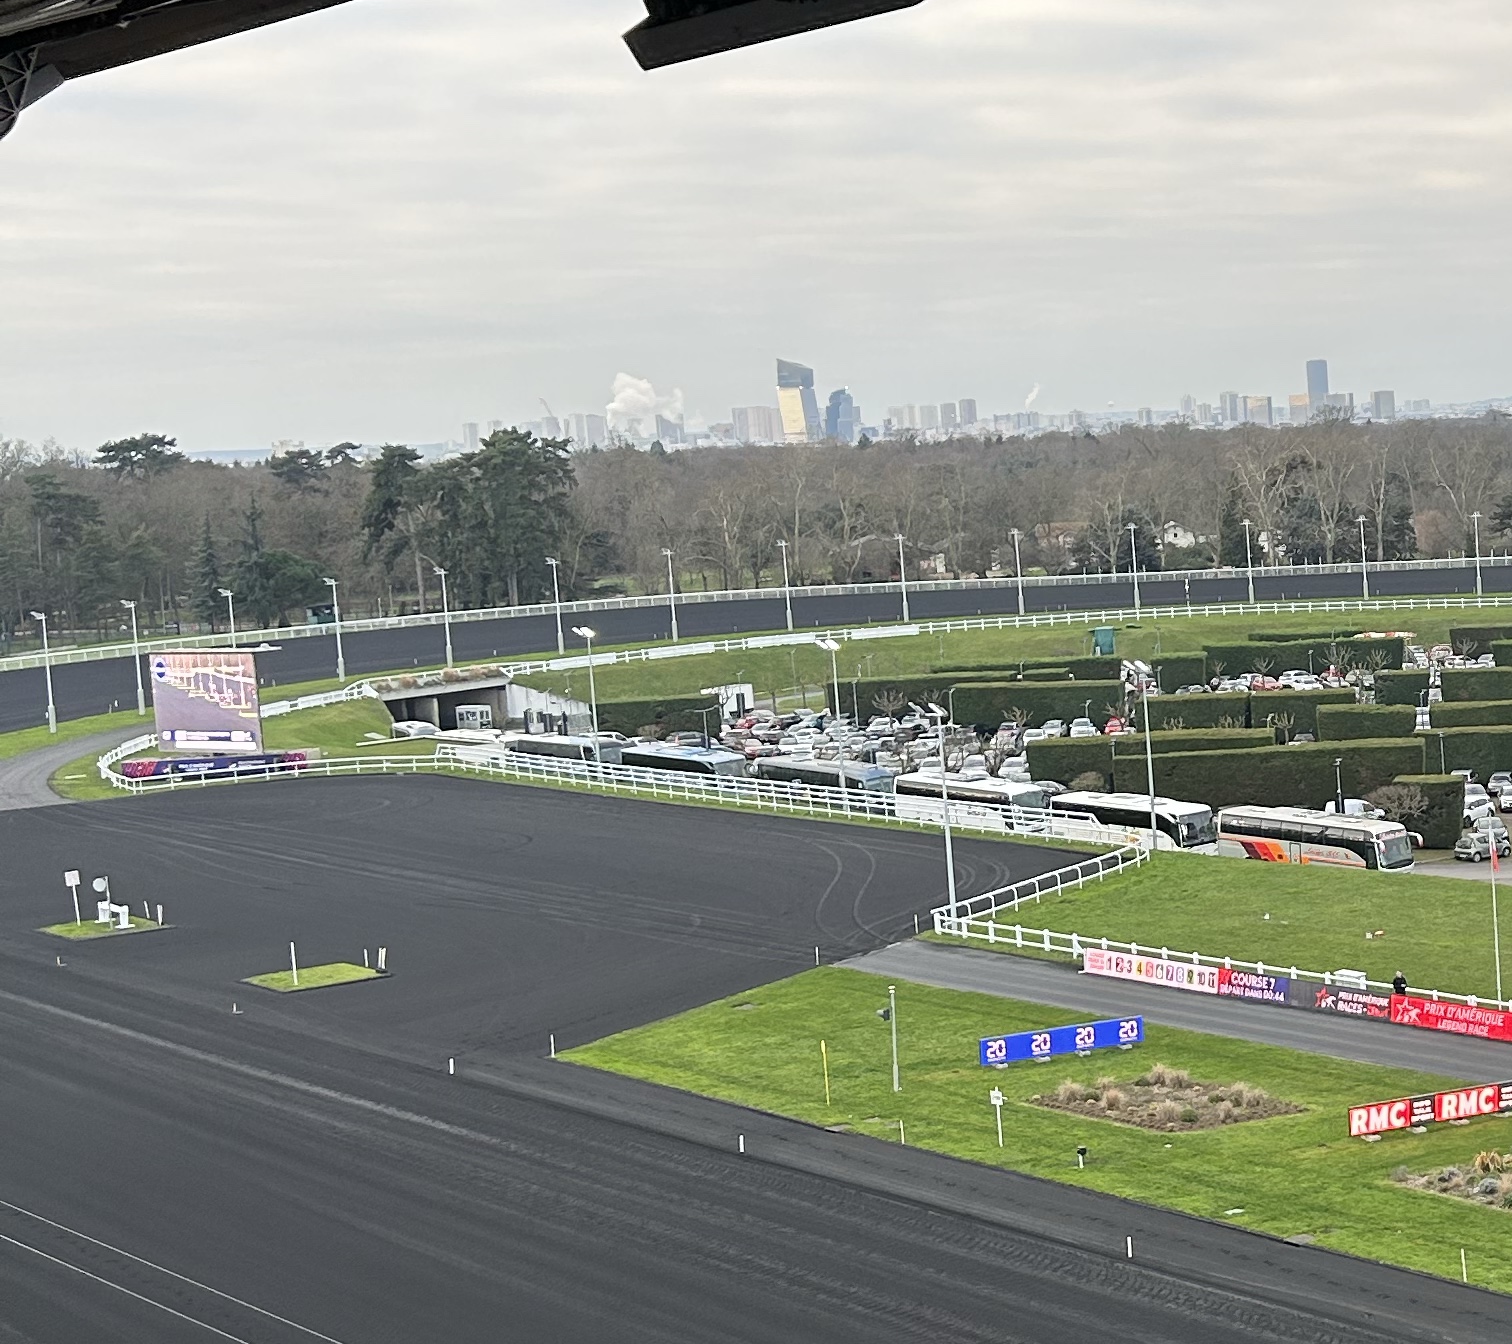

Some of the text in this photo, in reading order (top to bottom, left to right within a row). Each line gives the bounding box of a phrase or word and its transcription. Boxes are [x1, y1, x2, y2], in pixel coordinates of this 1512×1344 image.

[1231, 971, 1276, 990] COURSE 7
[1424, 1003, 1505, 1026] PRIX D'AMÉRIQUE
[1437, 1018, 1489, 1036] LEGEND RACE
[986, 1020, 1138, 1059] 20 20 20 20
[1350, 1087, 1494, 1136] RMC RMC
